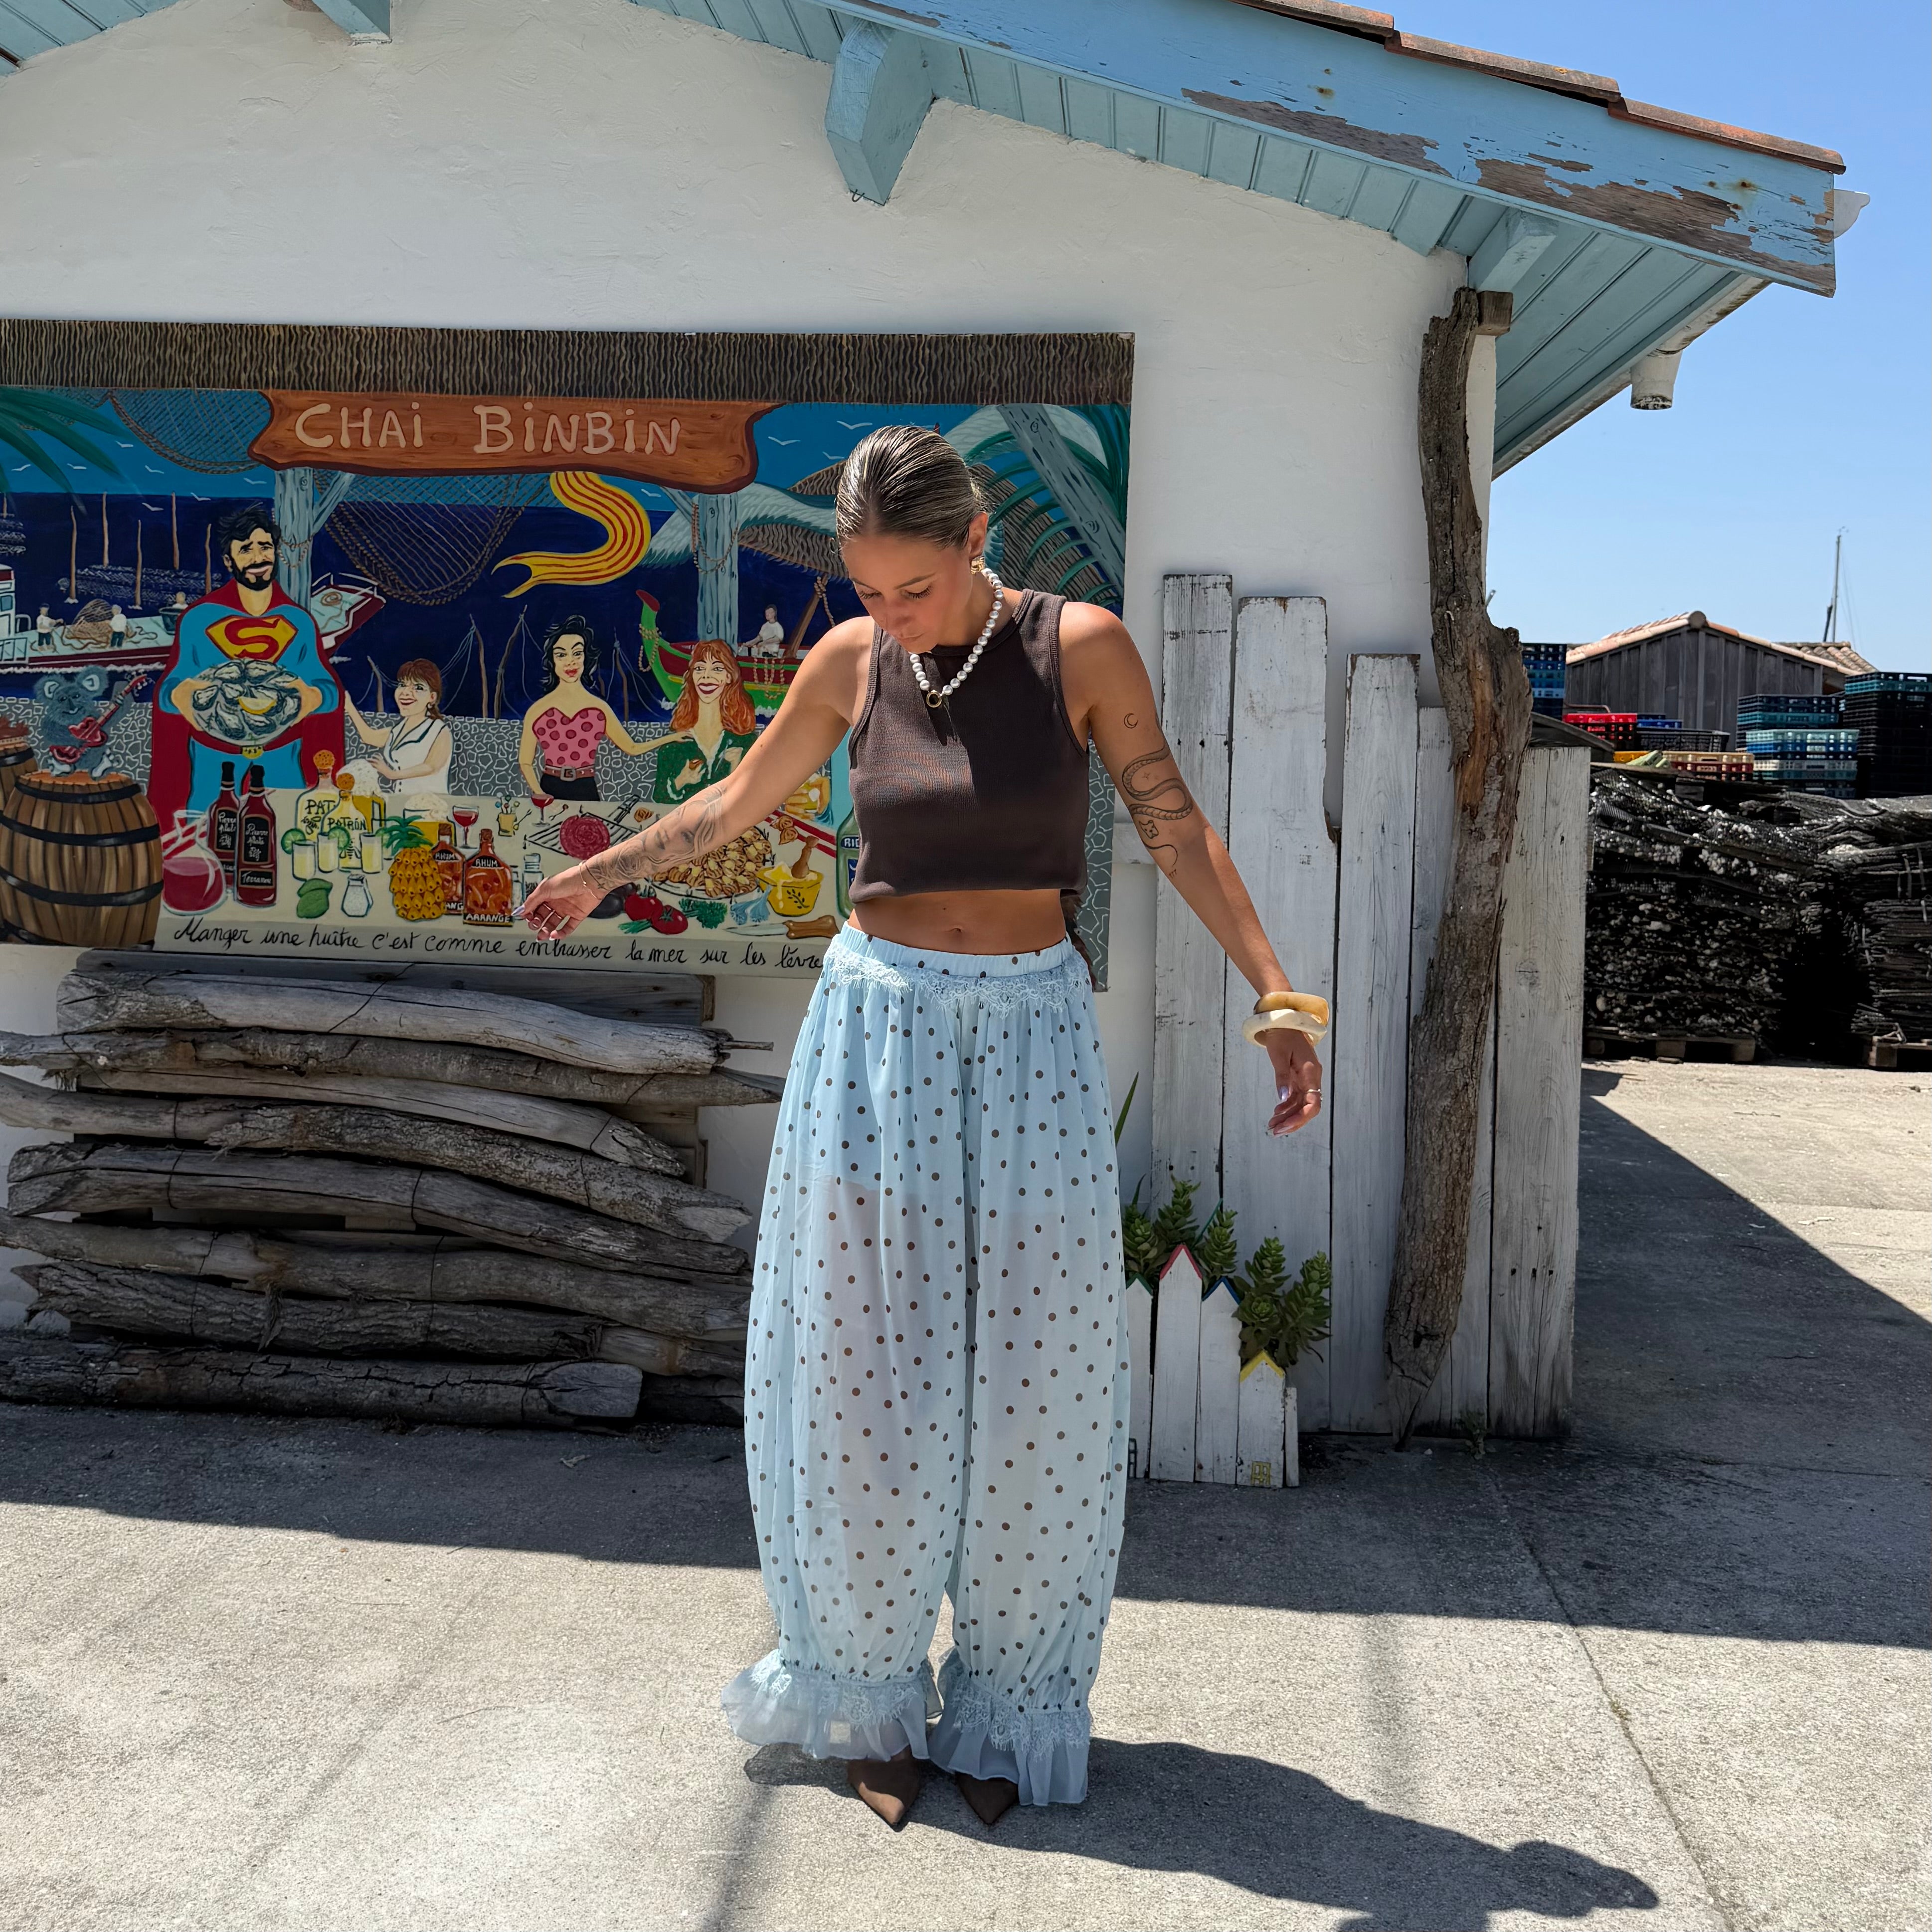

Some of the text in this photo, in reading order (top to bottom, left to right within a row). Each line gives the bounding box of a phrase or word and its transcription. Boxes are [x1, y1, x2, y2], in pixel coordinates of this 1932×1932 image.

[224, 618, 280, 660] S
[305, 799, 336, 815] PAT
[435, 852, 456, 861] RHUM
[475, 859, 498, 868] RHUM
[445, 902, 464, 910] ANG
[175, 917, 252, 950] Manger
[260, 930, 304, 945] une
[309, 924, 367, 948] huître
[425, 935, 505, 954] comme
[515, 939, 613, 959] embrasser
[625, 939, 644, 961] la
[648, 948, 687, 964] mer
[700, 949, 730, 964] sur
[740, 942, 766, 966] les
